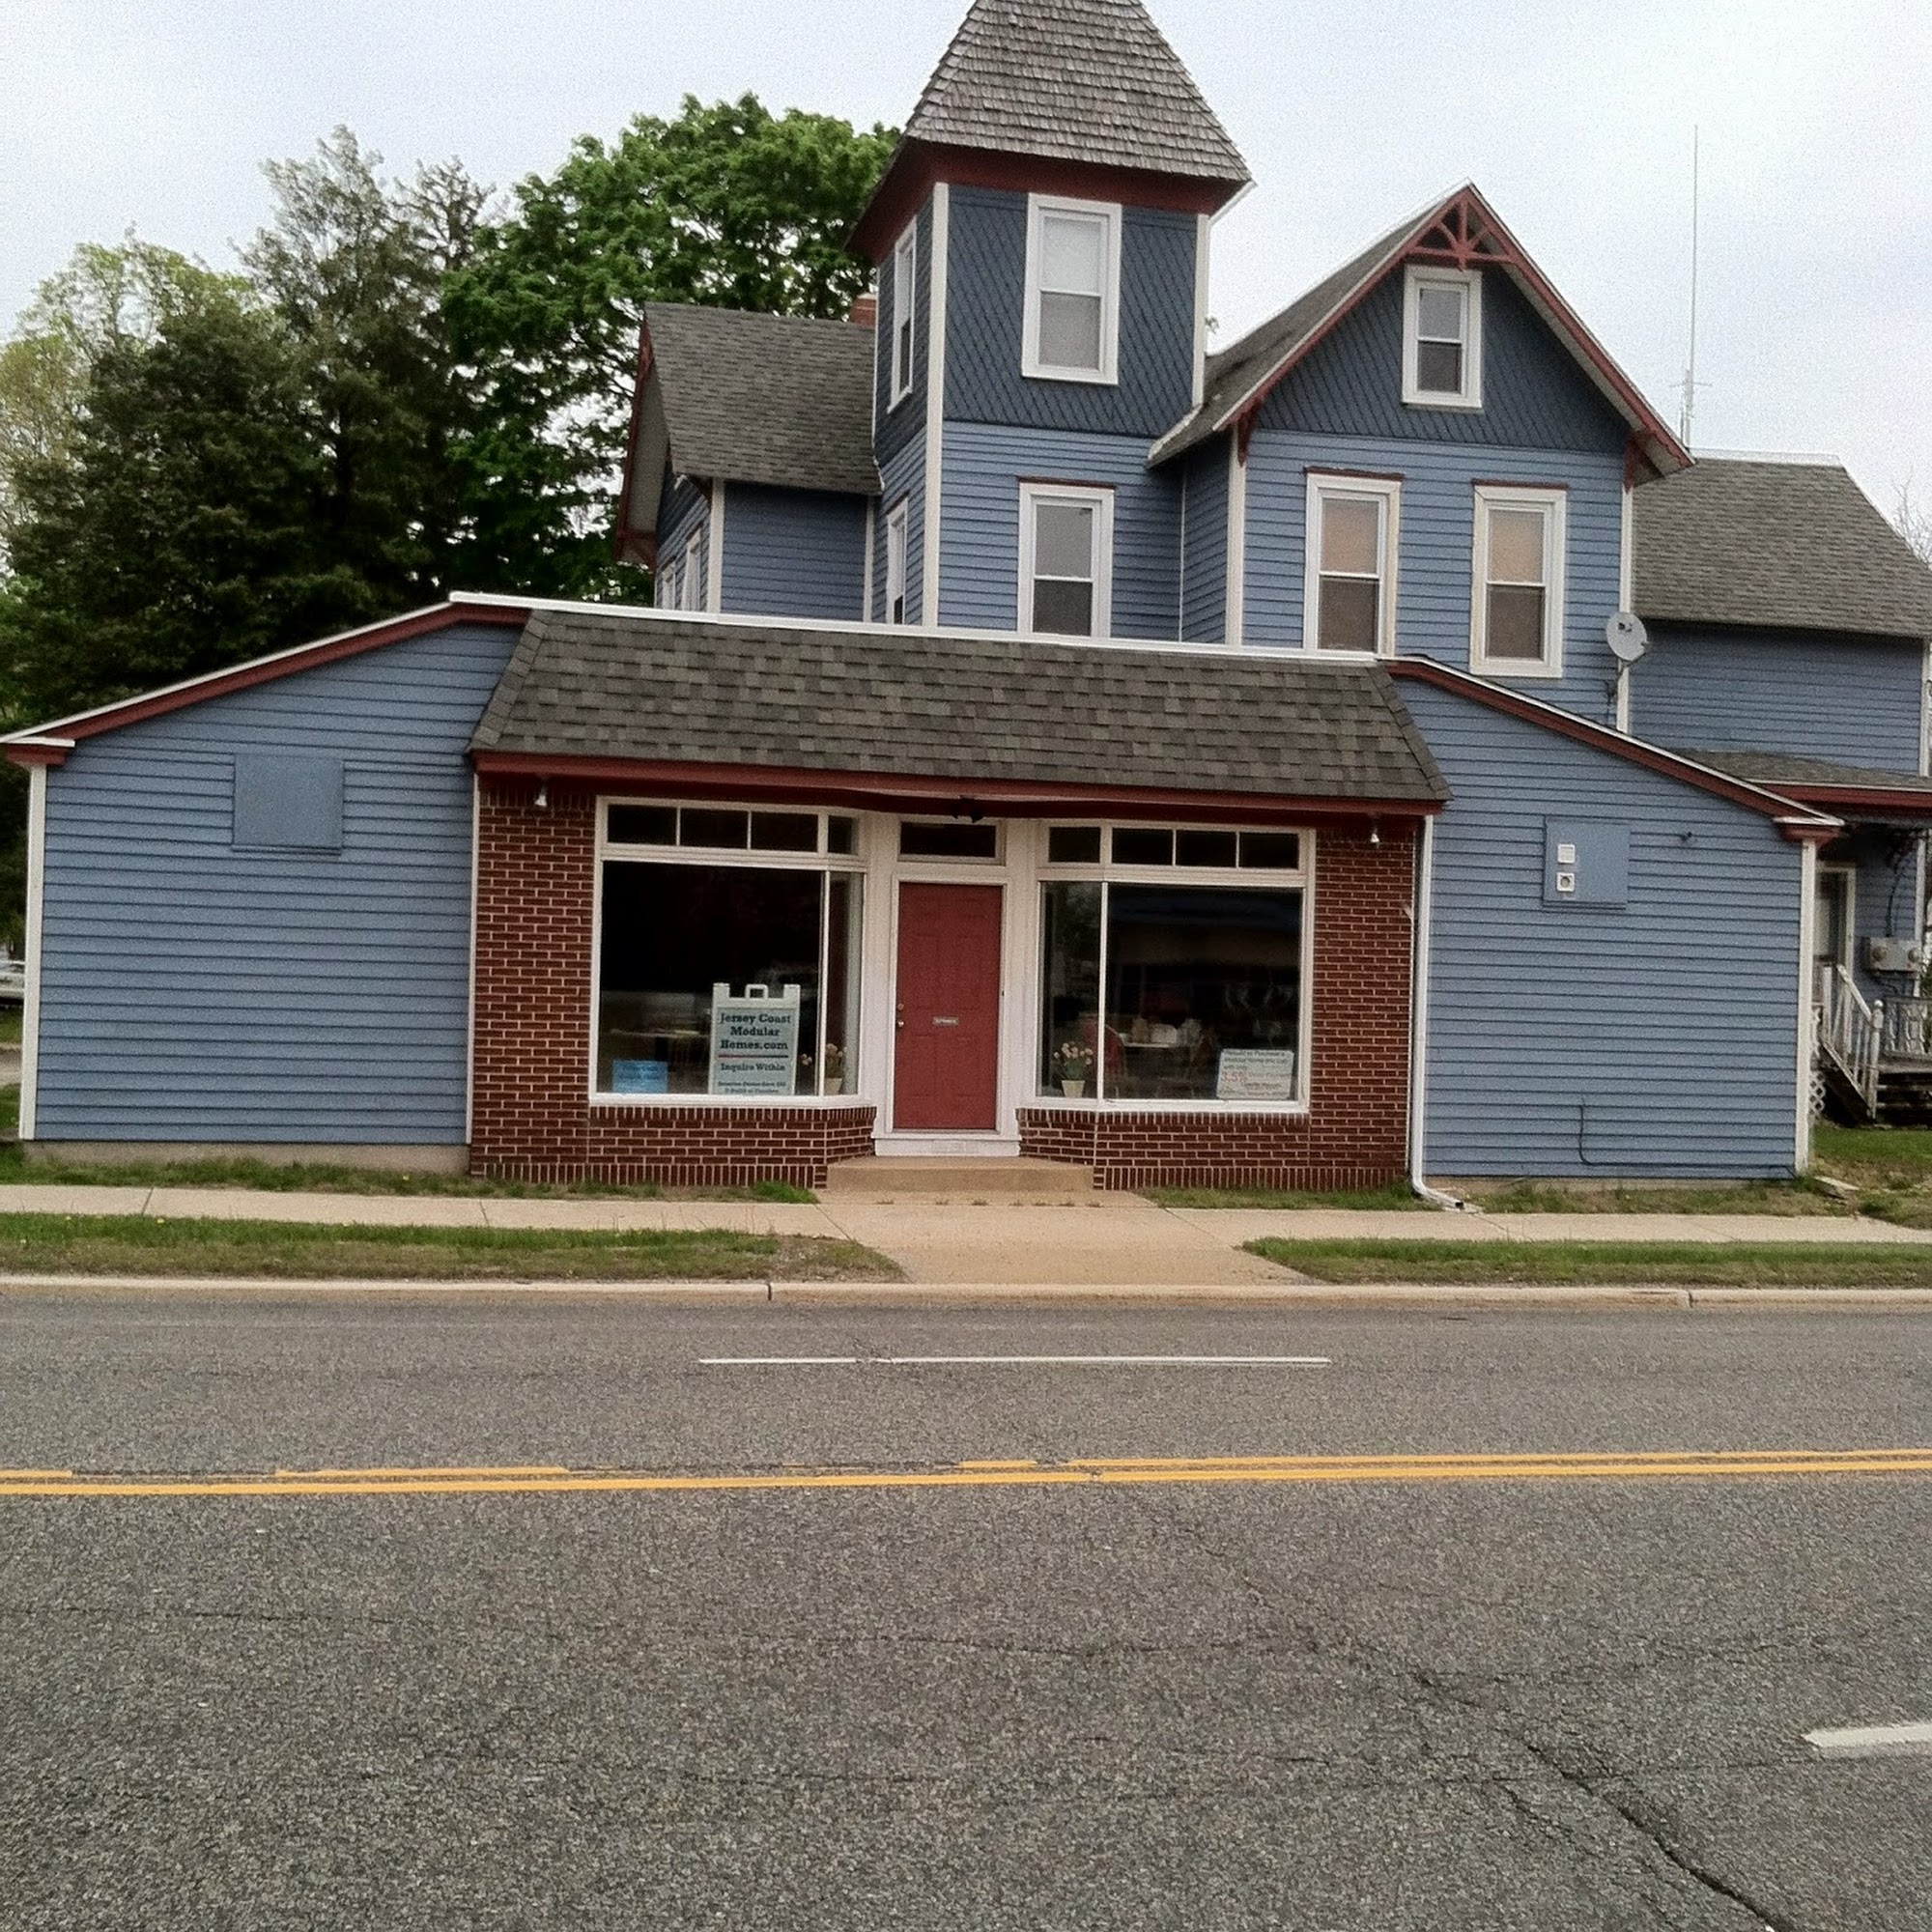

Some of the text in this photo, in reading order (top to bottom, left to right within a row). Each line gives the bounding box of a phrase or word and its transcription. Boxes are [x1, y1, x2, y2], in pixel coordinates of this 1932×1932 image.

[721, 1013, 791, 1025] Jersey Coast
[730, 1026, 781, 1037] Modular
[720, 1039, 788, 1050] Homes.com
[721, 1063, 785, 1073] Inquire Within
